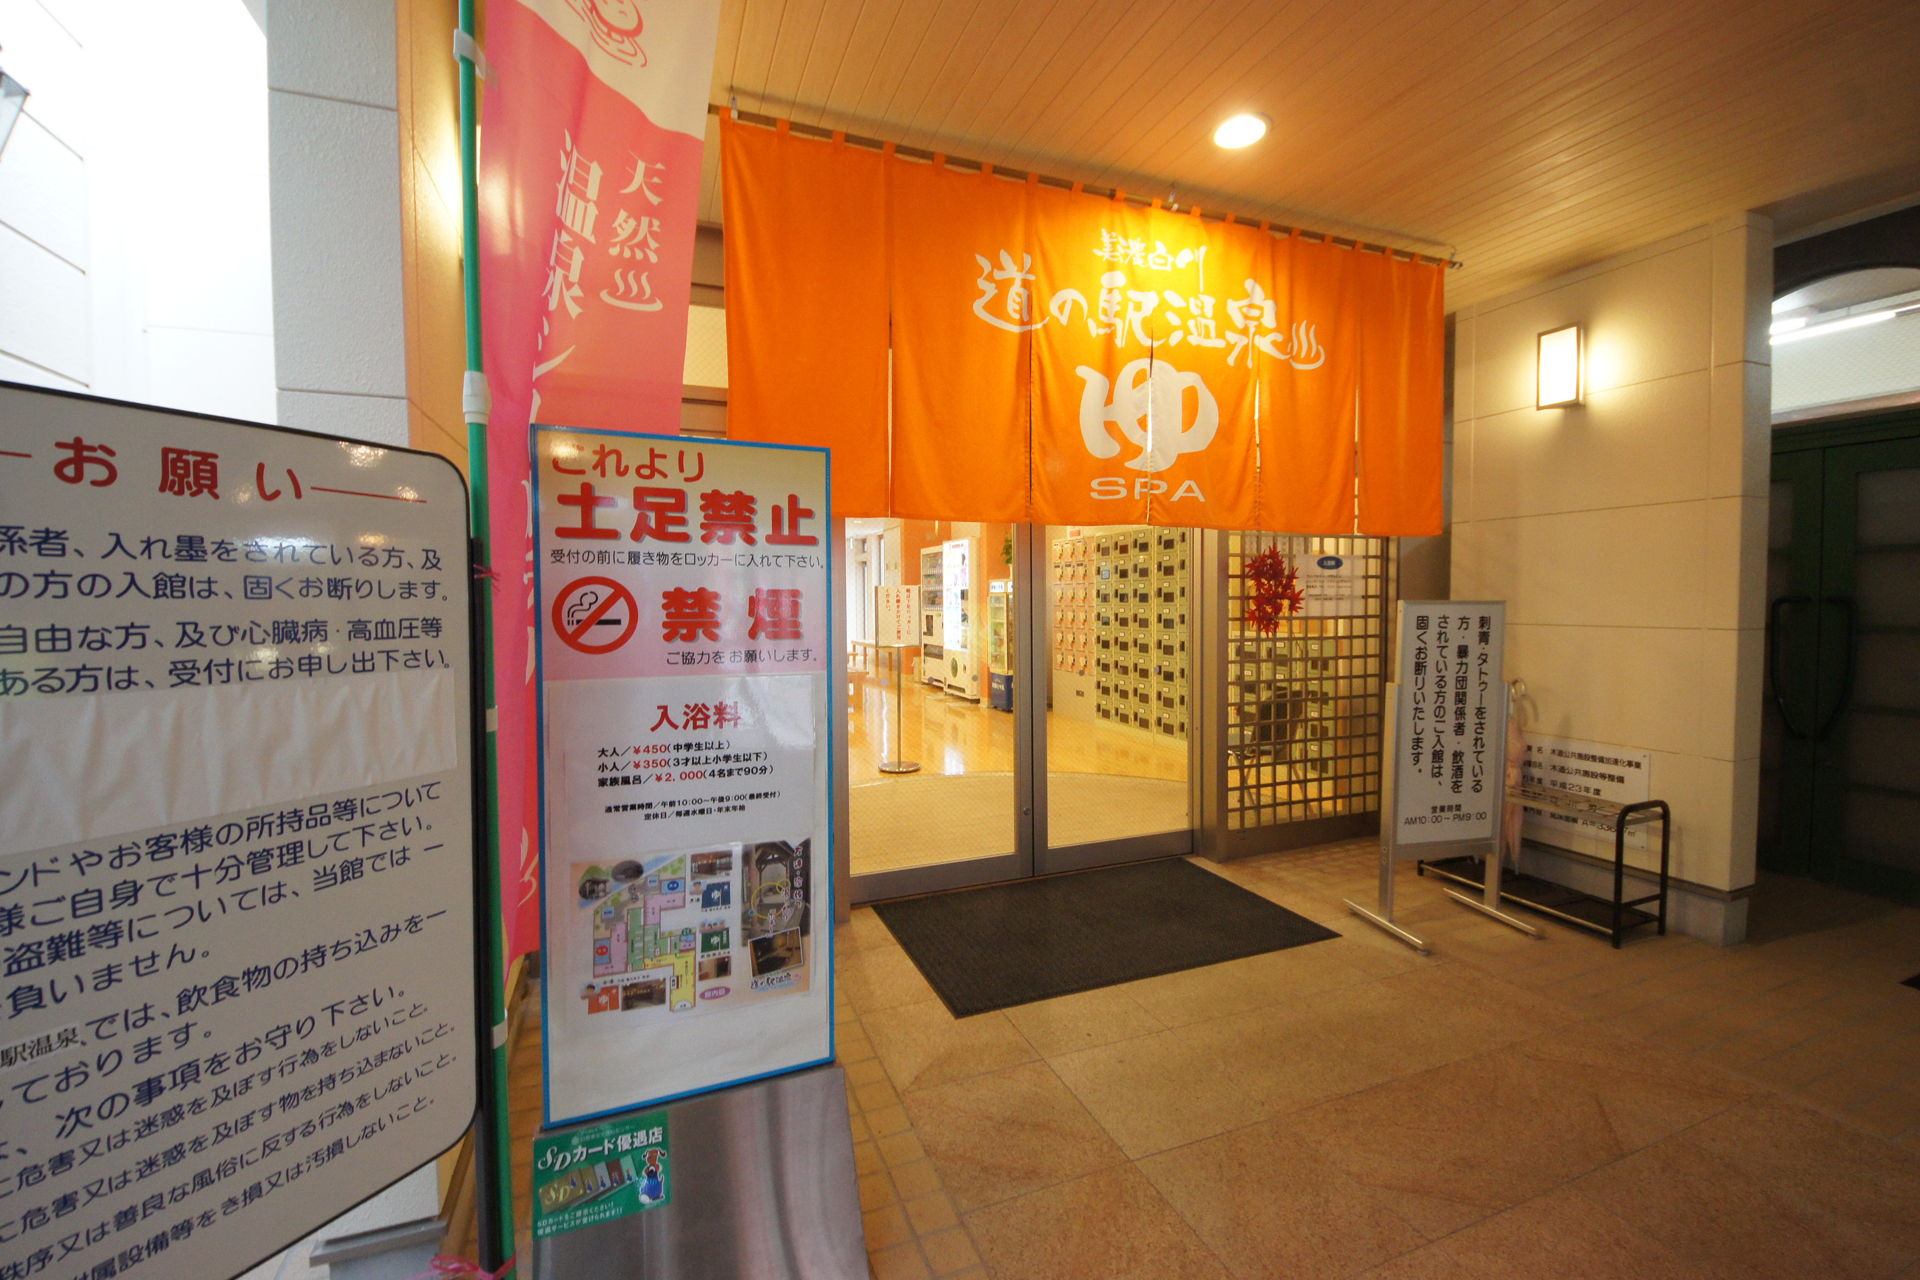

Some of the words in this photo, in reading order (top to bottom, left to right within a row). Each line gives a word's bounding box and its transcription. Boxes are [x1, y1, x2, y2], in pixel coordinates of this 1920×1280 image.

[542, 128, 603, 319] 温泉
[608, 150, 666, 264] 天然
[973, 249, 1291, 369] 道の駅温泉
[1076, 357, 1219, 473] ゆ
[53, 436, 303, 501] お願い
[552, 443, 704, 482] これより
[1090, 477, 1206, 502] SPA
[554, 482, 819, 546] 土足禁止
[0, 570, 448, 601] の方の入館は、固くお断りします。
[550, 549, 824, 569] 受付の前に履き物をロッカーに入れて下さい。
[0, 616, 443, 654] 自由な方、及び心臓病・高血圧等
[661, 586, 804, 643] 禁煙
[0, 649, 449, 696] ある方は、受付にお申し出下さい。
[666, 648, 818, 665] ご協力をお願いします。
[650, 701, 742, 732] 入浴料
[1411, 615, 1429, 774] 固くお断りいたします。
[1431, 614, 1450, 786] されている方のご入館は、
[1450, 615, 1471, 794] 方・暴力団関係者・飲酒を
[1471, 615, 1491, 793] 刺青・タトゥーをされている
[1431, 804, 1462, 814] 営業時間
[1550, 779, 1602, 796] 平成23年度
[0, 781, 441, 895] ンドやお客様の所持品等について
[6, 943, 209, 1019] 負いません。
[12, 1022, 211, 1104] ております。
